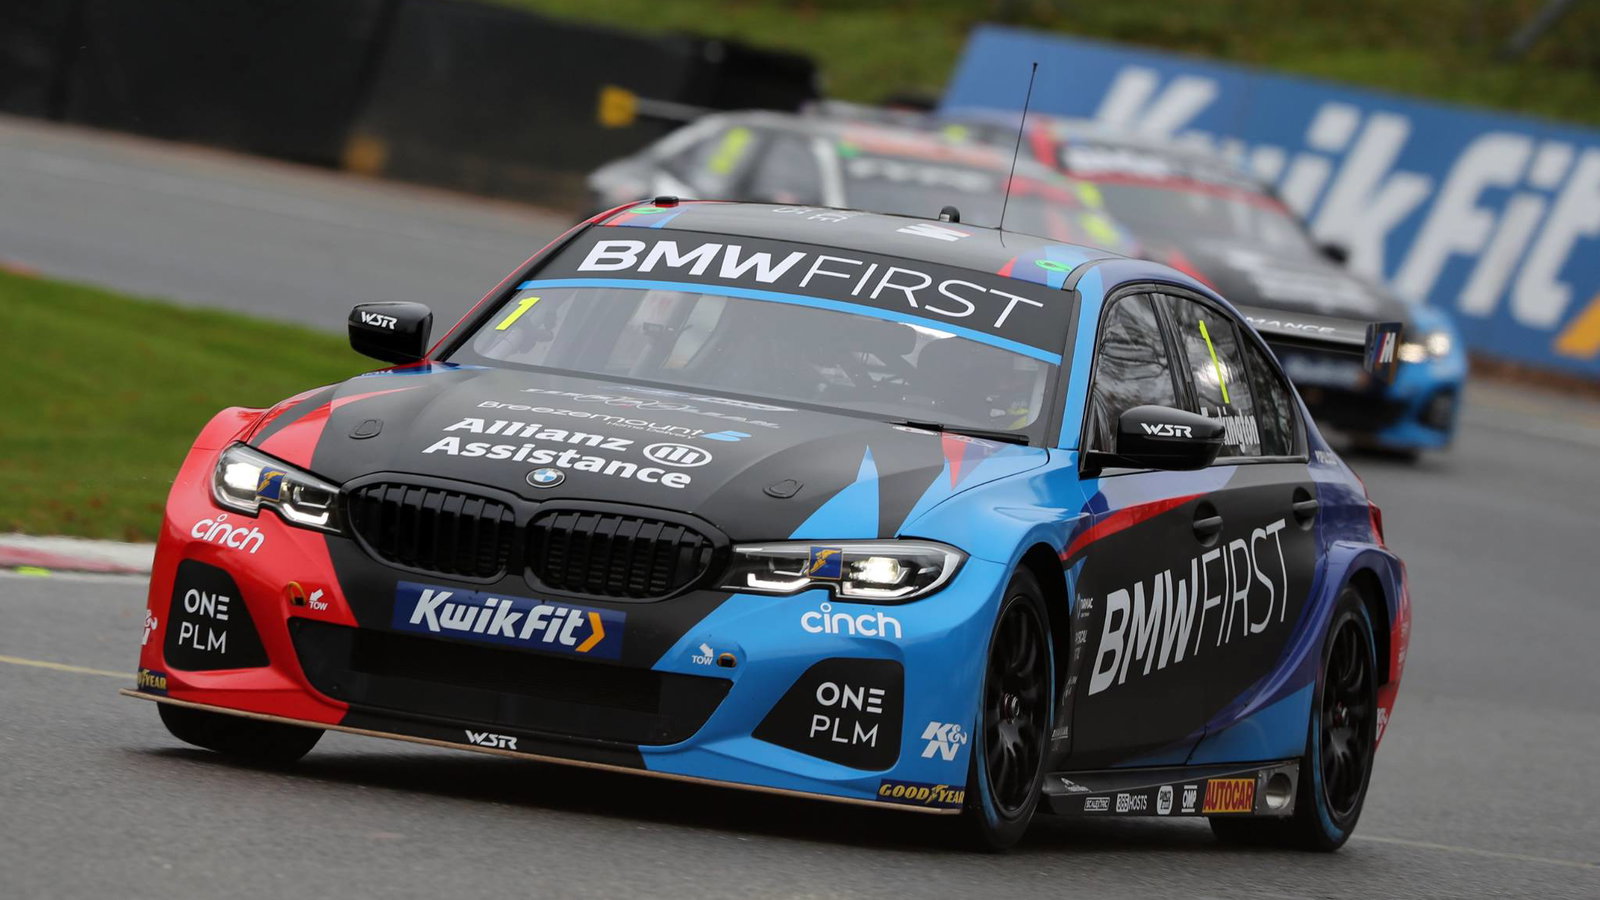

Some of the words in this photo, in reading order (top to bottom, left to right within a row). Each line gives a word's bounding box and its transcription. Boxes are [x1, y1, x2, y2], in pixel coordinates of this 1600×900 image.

[361, 311, 397, 329] WSR
[495, 297, 541, 330] 1
[443, 417, 635, 451] Allianz
[477, 400, 704, 435] Breezemount
[1140, 422, 1193, 439] WSR
[1201, 406, 1261, 453] kington
[422, 436, 692, 489] Assistance
[191, 514, 265, 553] cinch
[184, 589, 230, 620] ONE
[309, 600, 328, 611] TOW
[800, 602, 902, 638] cinch
[178, 621, 227, 654] PLM
[691, 655, 713, 666] TOW
[138, 670, 167, 689] YEAR
[816, 681, 885, 714] ONE
[465, 730, 518, 751] WSR
[809, 714, 880, 748] PLM
[921, 721, 968, 761] K&N
[1182, 790, 1197, 808] OMP
[1204, 780, 1255, 811] AUTOCAR
